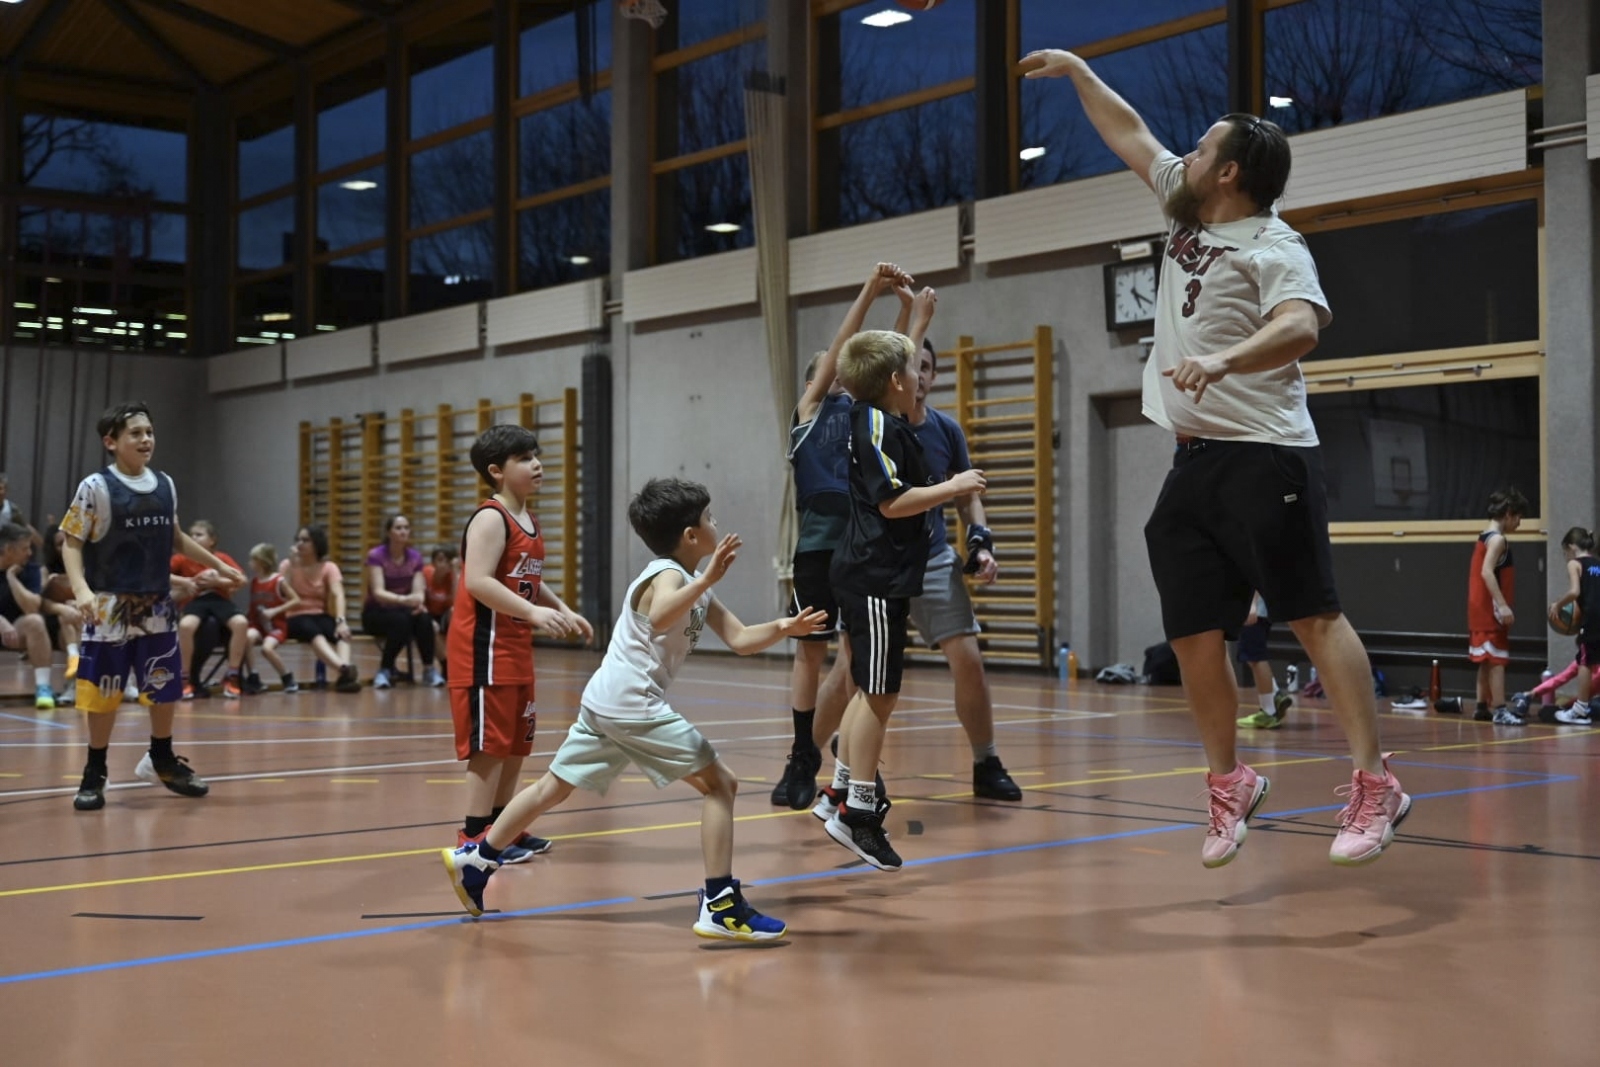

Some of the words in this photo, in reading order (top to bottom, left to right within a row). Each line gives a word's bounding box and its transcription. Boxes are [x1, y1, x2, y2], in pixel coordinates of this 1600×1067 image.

[1182, 279, 1202, 318] 3
[126, 515, 170, 528] KIPSTA
[506, 551, 541, 578] LAK
[99, 674, 122, 699] 00
